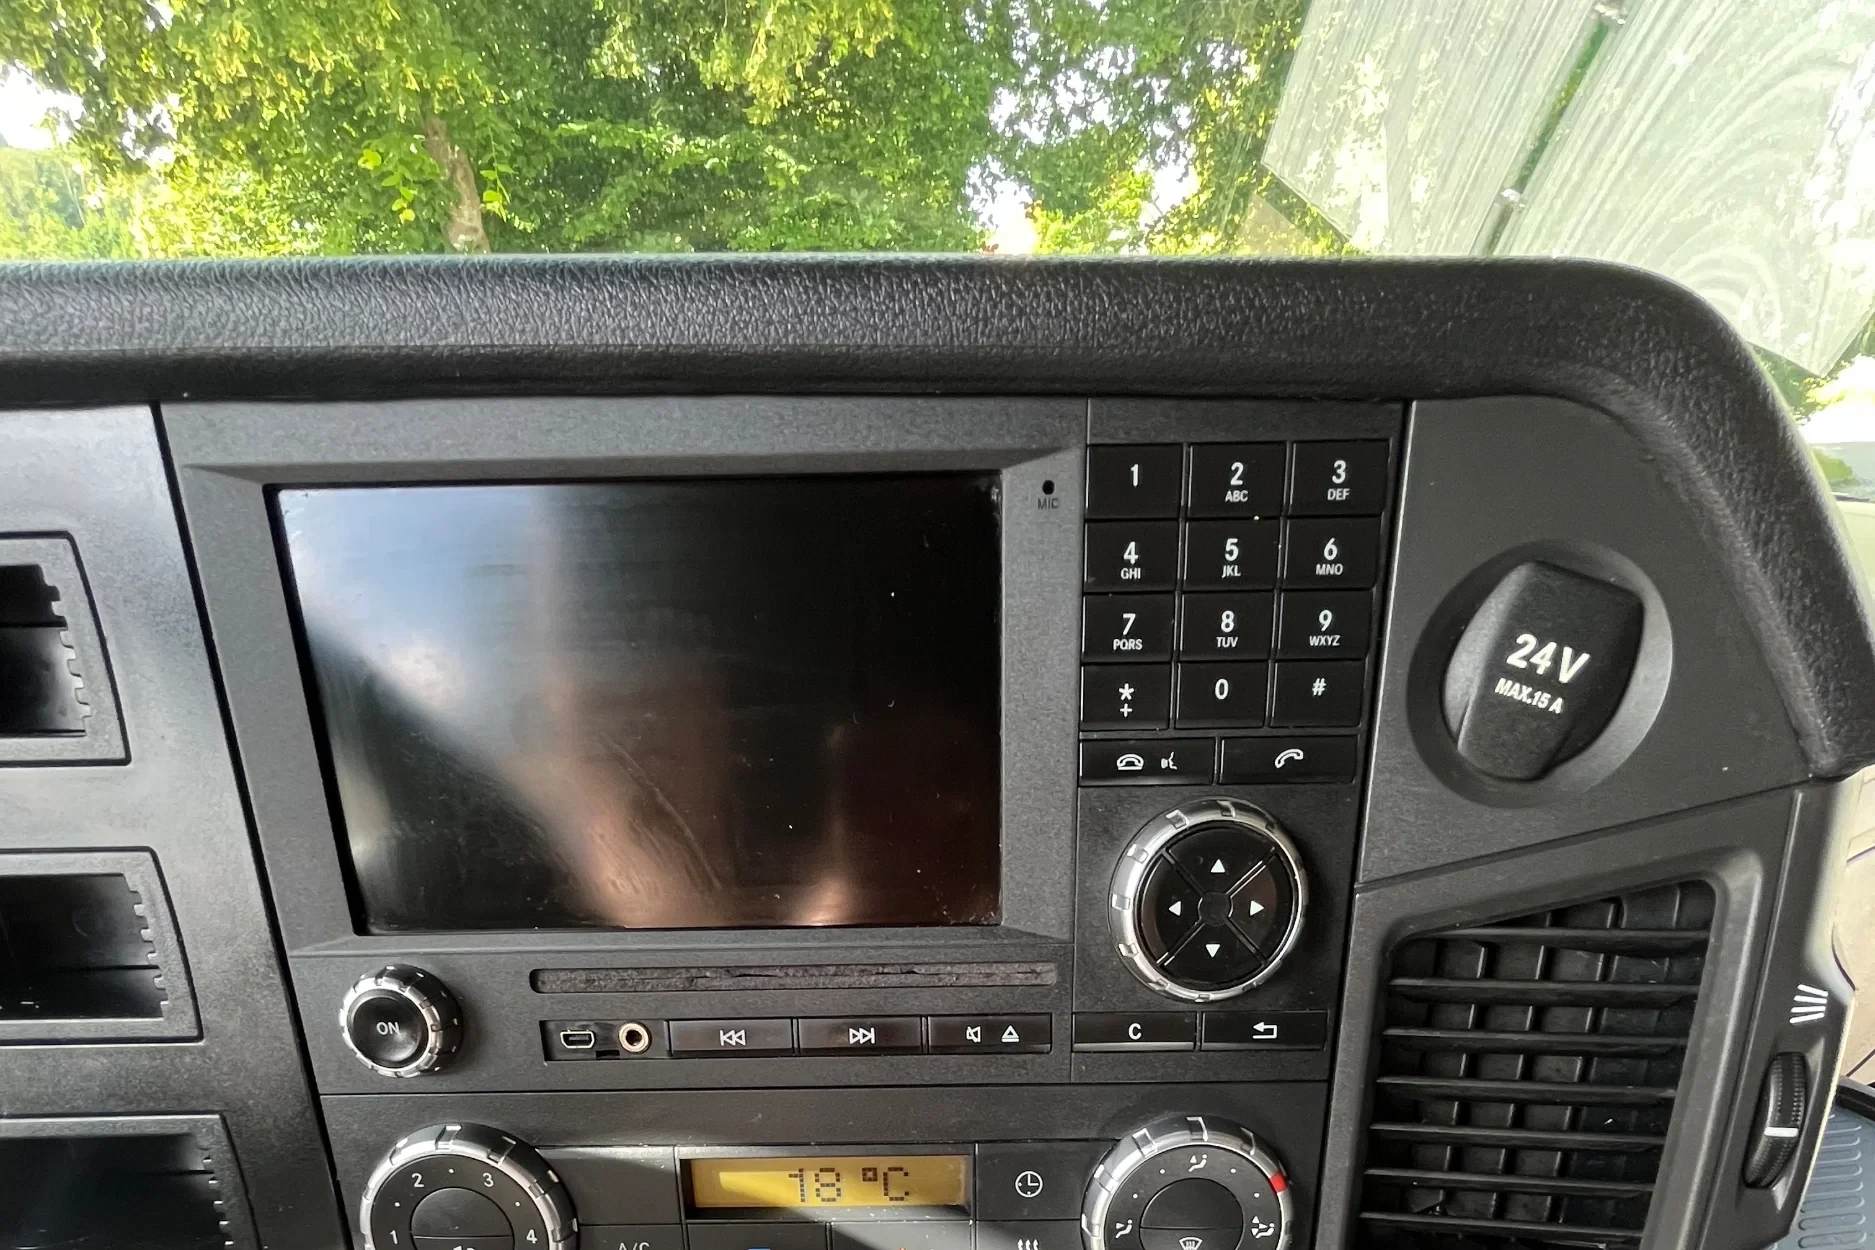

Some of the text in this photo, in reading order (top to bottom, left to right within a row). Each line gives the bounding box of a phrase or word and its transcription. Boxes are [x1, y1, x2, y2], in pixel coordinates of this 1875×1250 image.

[1131, 463, 1140, 487] 1
[1230, 462, 1244, 486] 2
[1332, 460, 1347, 484] 3
[1224, 490, 1249, 503] ABC
[1327, 488, 1350, 501] DEF
[1037, 498, 1059, 510] MIC
[1123, 541, 1139, 564] 4
[1224, 538, 1239, 562] 5
[1323, 537, 1338, 560] 6
[1120, 567, 1141, 580] GHI
[1221, 565, 1241, 578] JKL
[1315, 563, 1343, 576] MNO
[1122, 613, 1136, 635] 7
[1220, 610, 1235, 632] 8
[1318, 609, 1333, 631] 9
[1113, 638, 1143, 651] PQRS
[1216, 636, 1239, 649] TUV
[1309, 635, 1341, 648] WXYZ
[1214, 679, 1229, 699] 0
[376, 1021, 401, 1036] ON
[1128, 1023, 1142, 1040] C
[411, 1173, 425, 1188] 2
[482, 1172, 494, 1187] 3
[788, 1167, 841, 1202] 18
[390, 1230, 399, 1244] 1
[526, 1229, 538, 1244] 4
